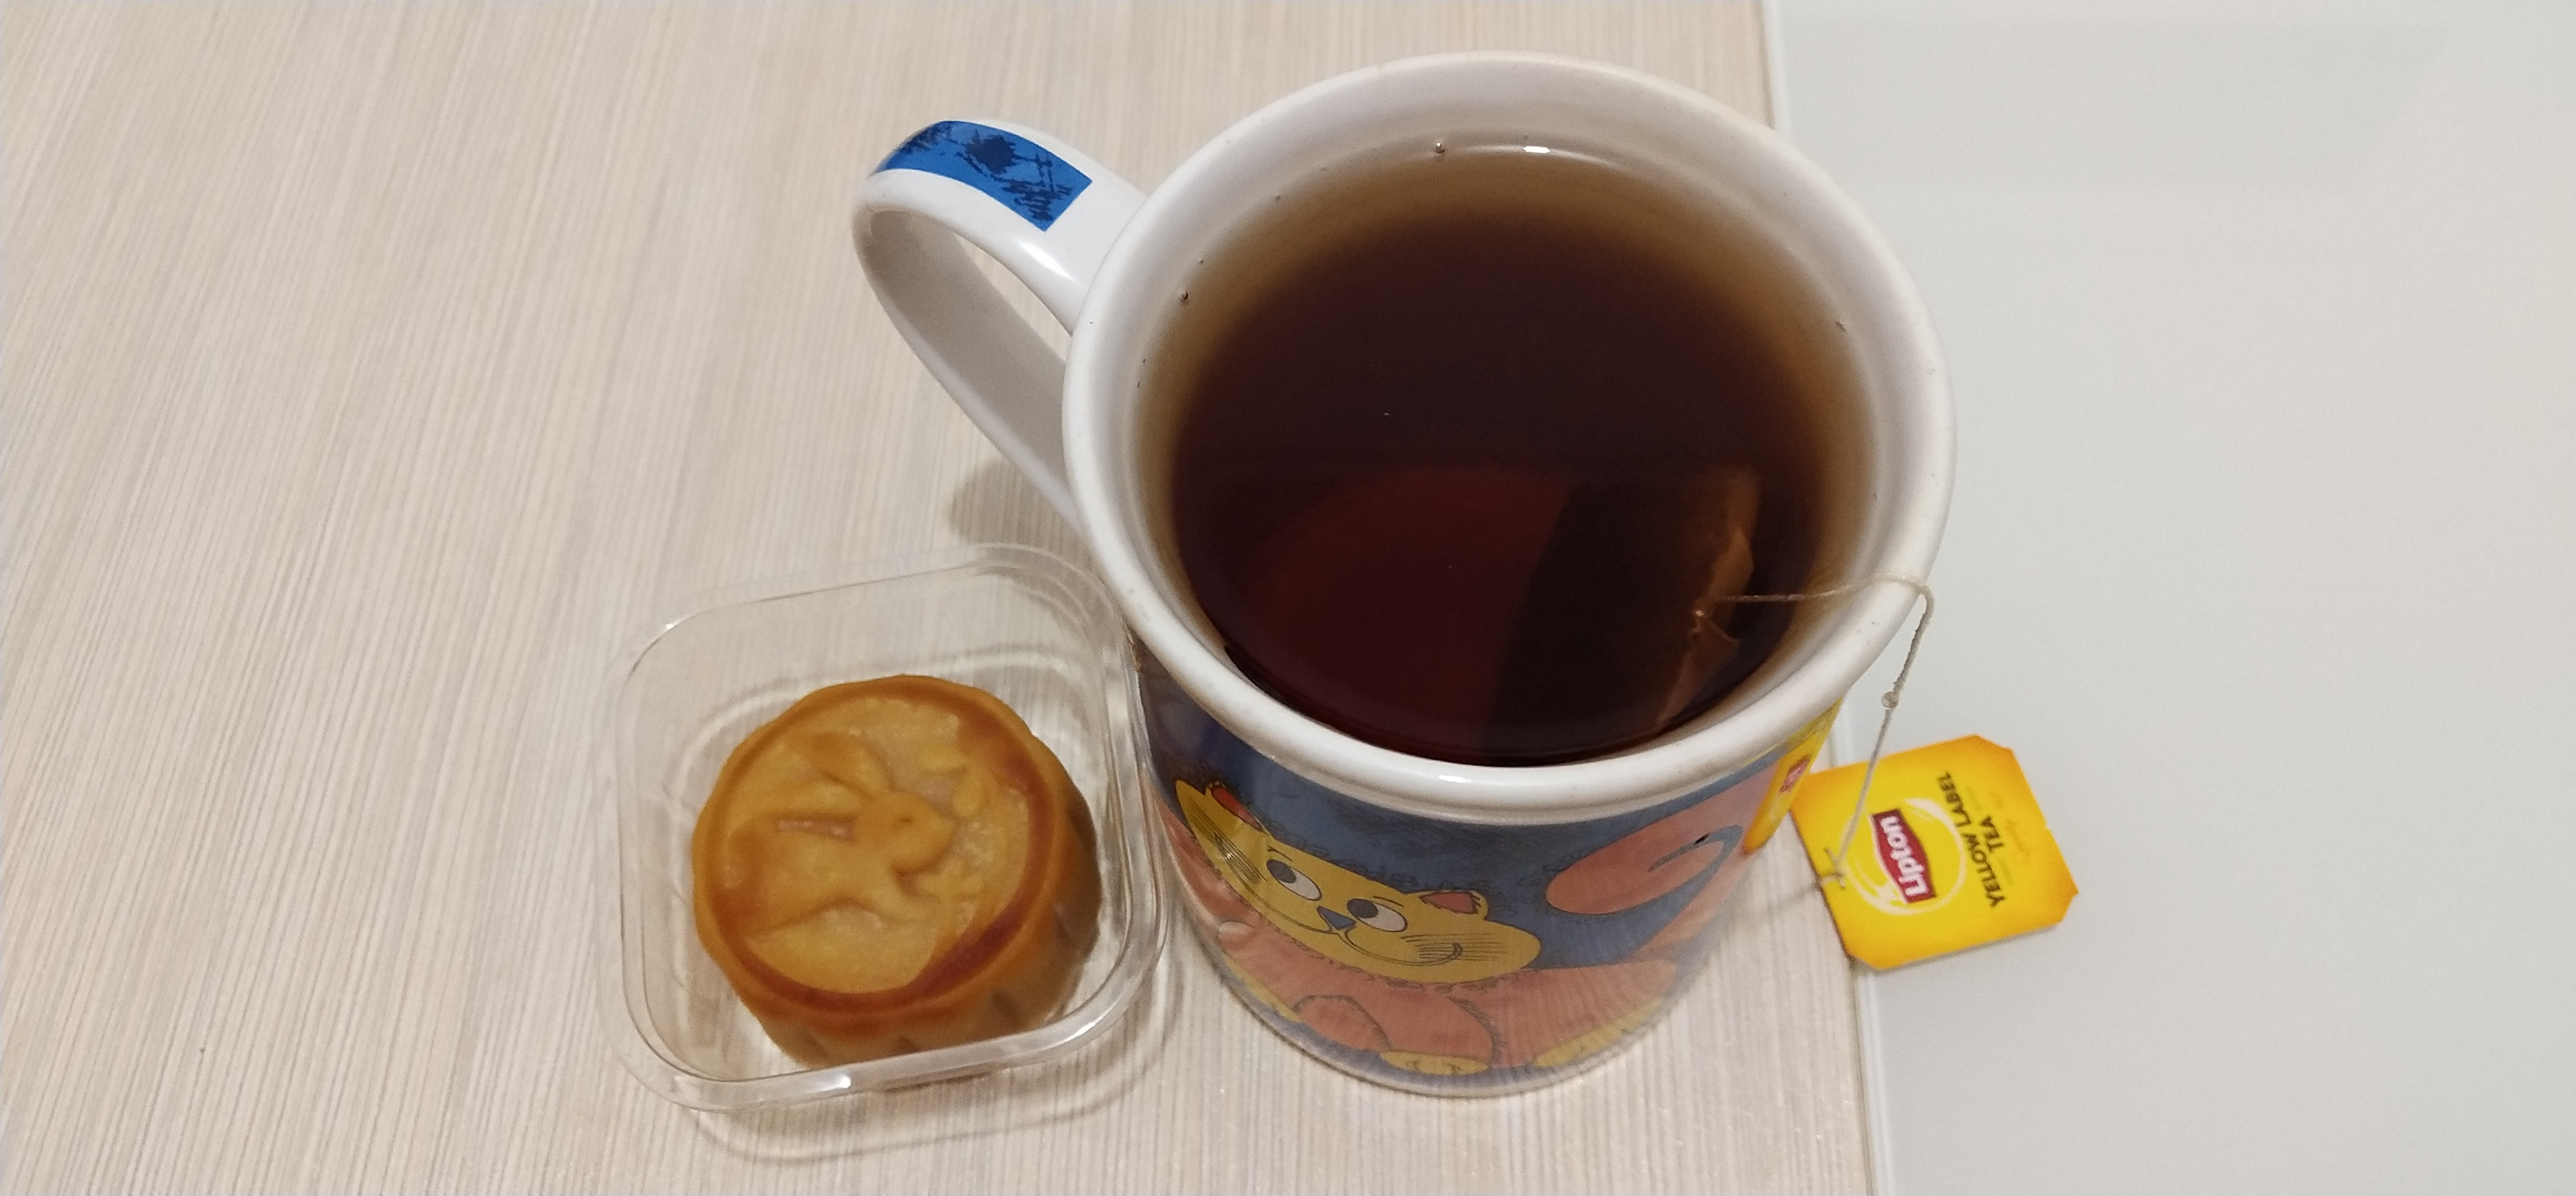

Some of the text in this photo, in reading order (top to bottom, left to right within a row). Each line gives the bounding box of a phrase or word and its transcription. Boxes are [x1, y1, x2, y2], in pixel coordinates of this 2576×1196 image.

[1880, 816, 1929, 896] Lipton
[1938, 771, 2005, 907] YELLOW LABEL
[1980, 815, 2004, 852] TEA
